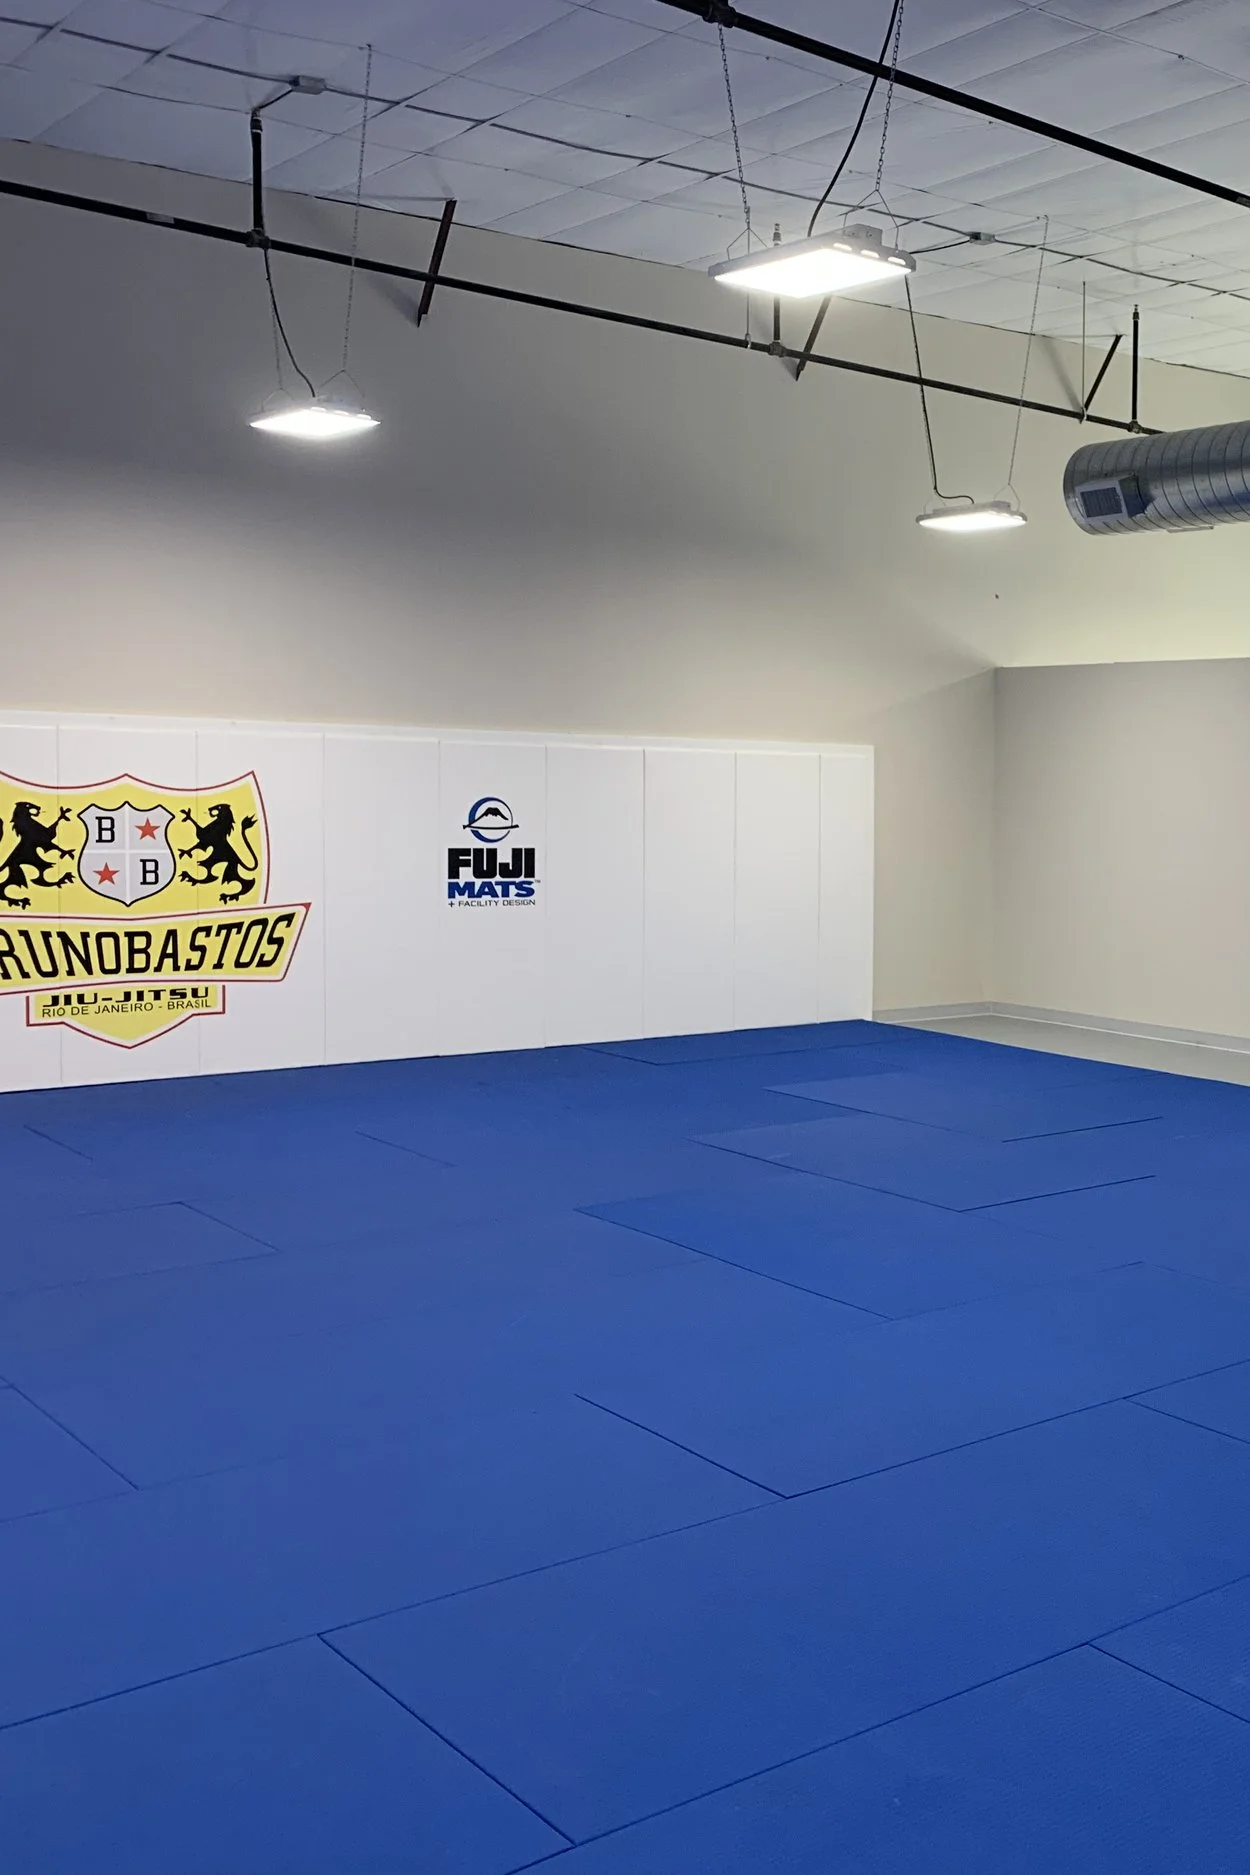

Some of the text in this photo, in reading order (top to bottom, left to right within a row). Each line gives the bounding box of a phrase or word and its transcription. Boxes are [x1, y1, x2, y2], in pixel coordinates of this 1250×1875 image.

[95, 816, 115, 843] B
[139, 858, 159, 886] B
[448, 848, 535, 879] FUJI
[448, 880, 535, 899] MATS
[502, 899, 536, 907] DESIGN
[43, 986, 209, 1007] JIU-JITSU
[42, 1008, 66, 1018] RIO
[71, 1006, 89, 1016] DE
[94, 1002, 153, 1015] JANEIRO
[167, 999, 211, 1010] BRASIL
